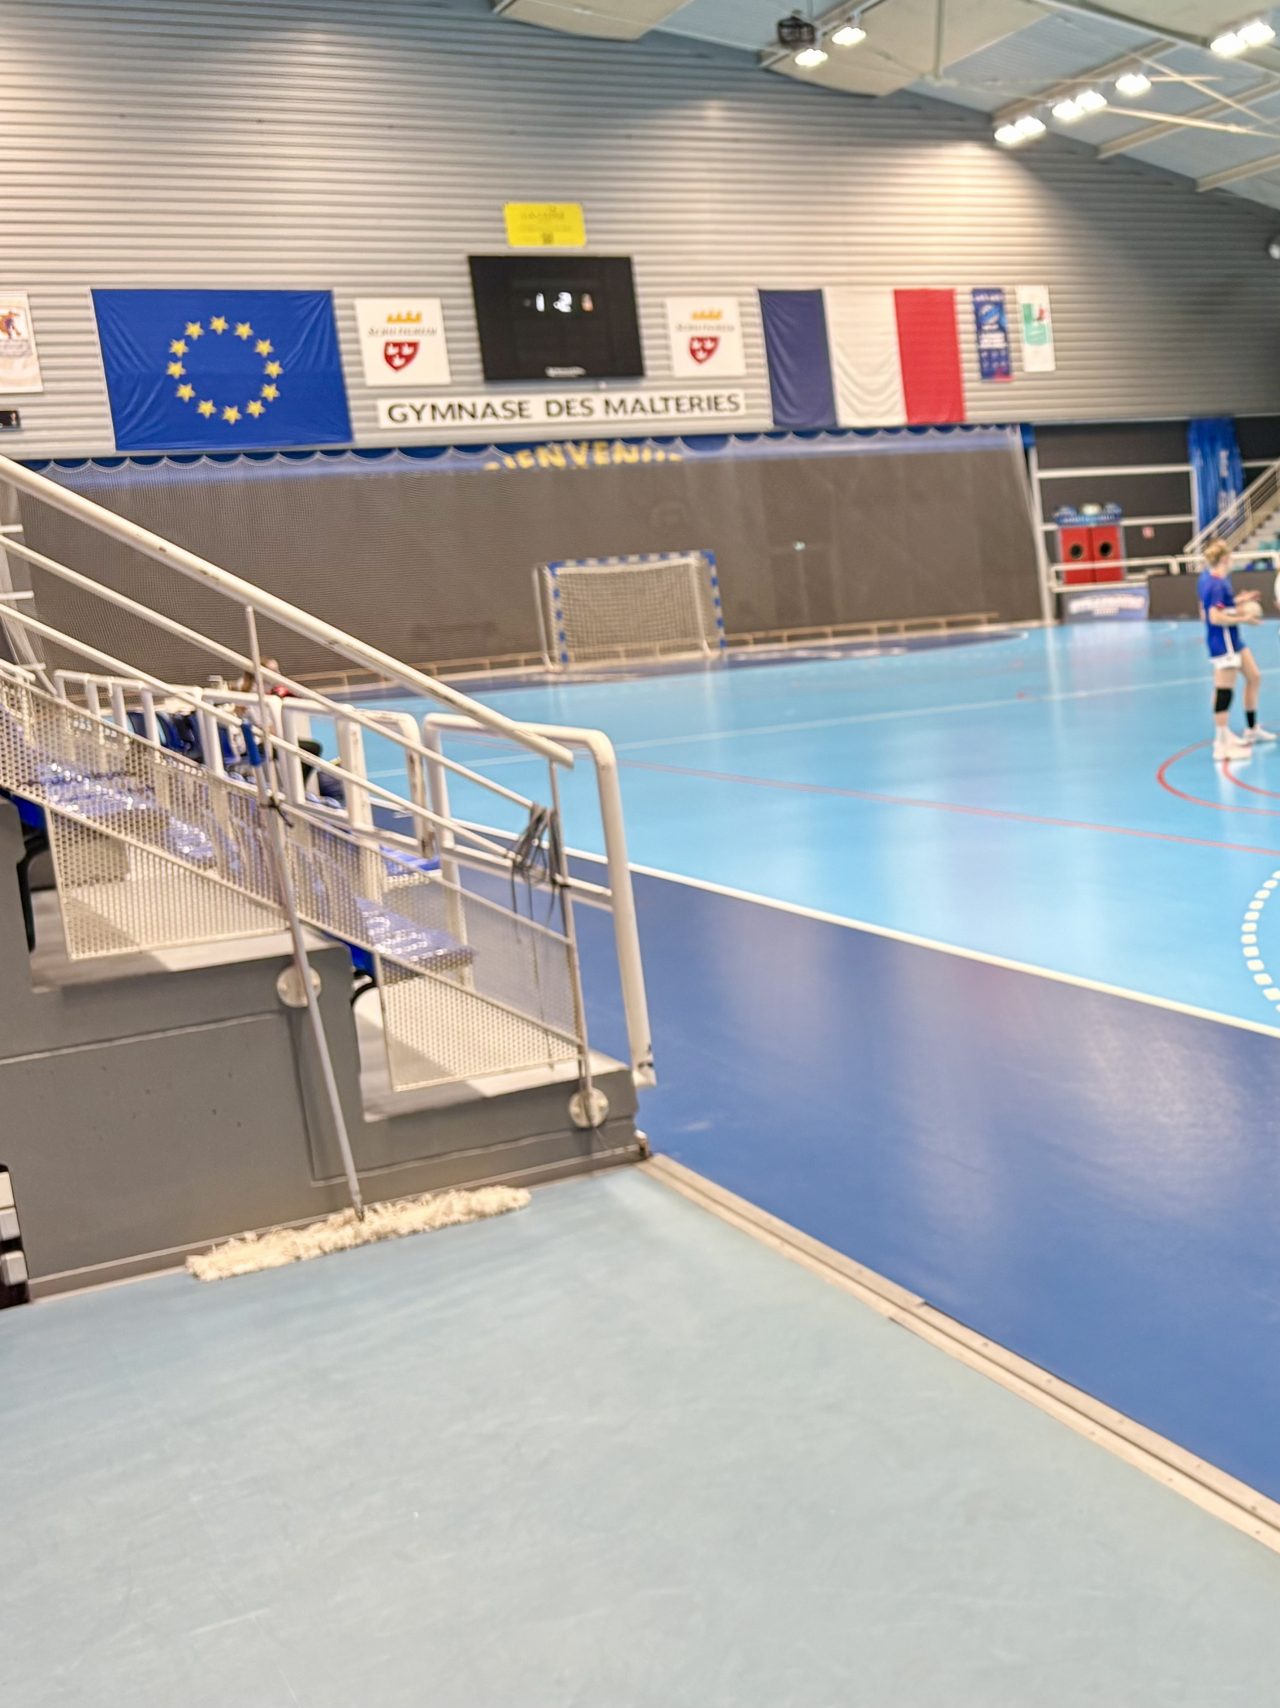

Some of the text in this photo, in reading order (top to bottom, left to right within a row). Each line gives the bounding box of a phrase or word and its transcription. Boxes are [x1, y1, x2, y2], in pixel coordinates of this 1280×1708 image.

[388, 393, 741, 424] GYMNASE DES MALTERIES
